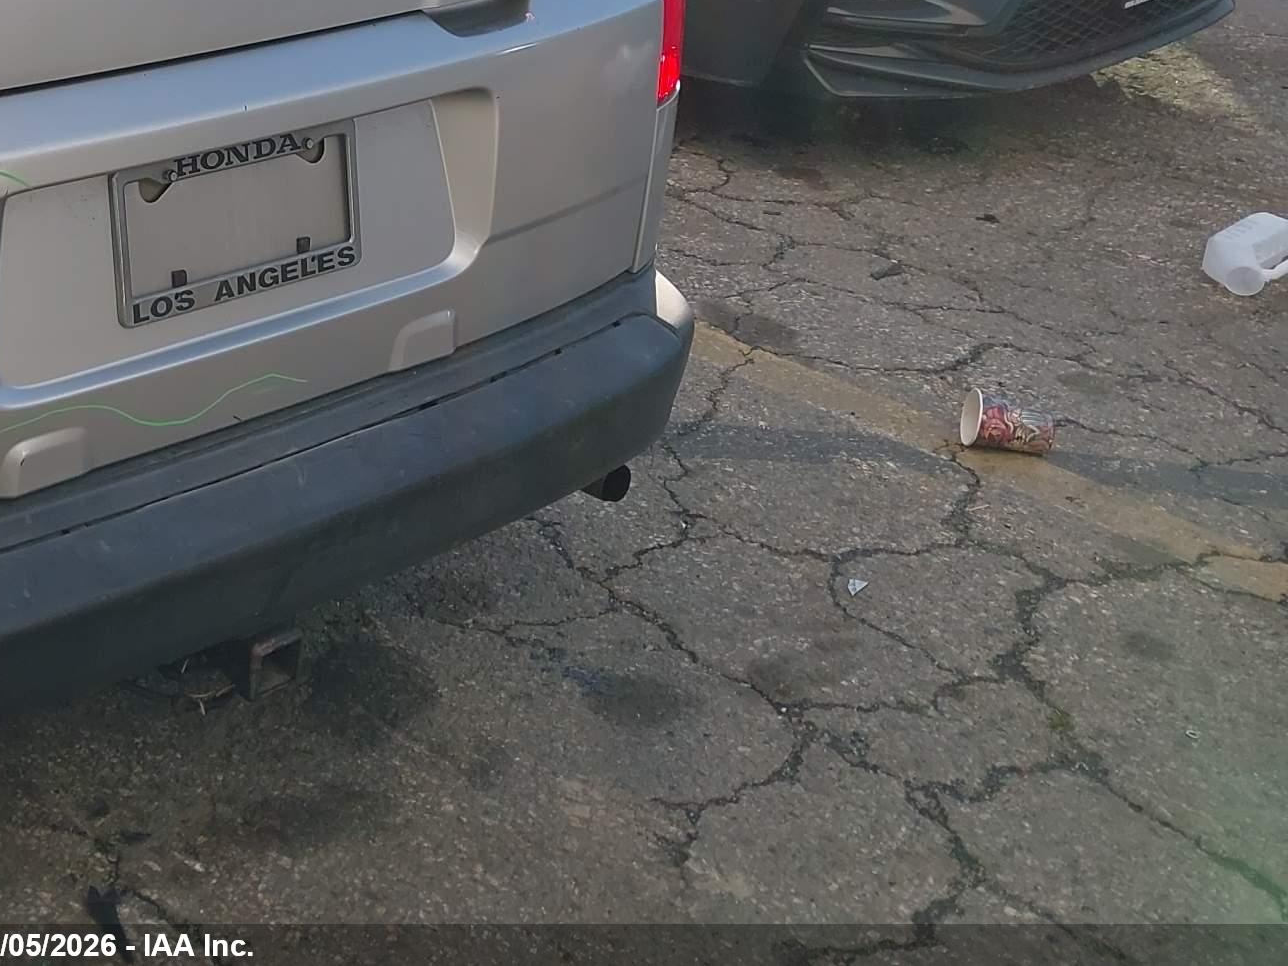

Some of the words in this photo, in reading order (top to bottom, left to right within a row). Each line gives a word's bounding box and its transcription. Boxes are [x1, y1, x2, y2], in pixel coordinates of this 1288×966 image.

[174, 133, 302, 176] HONDA
[133, 289, 196, 325] LOS
[214, 246, 357, 302] ANGELES
